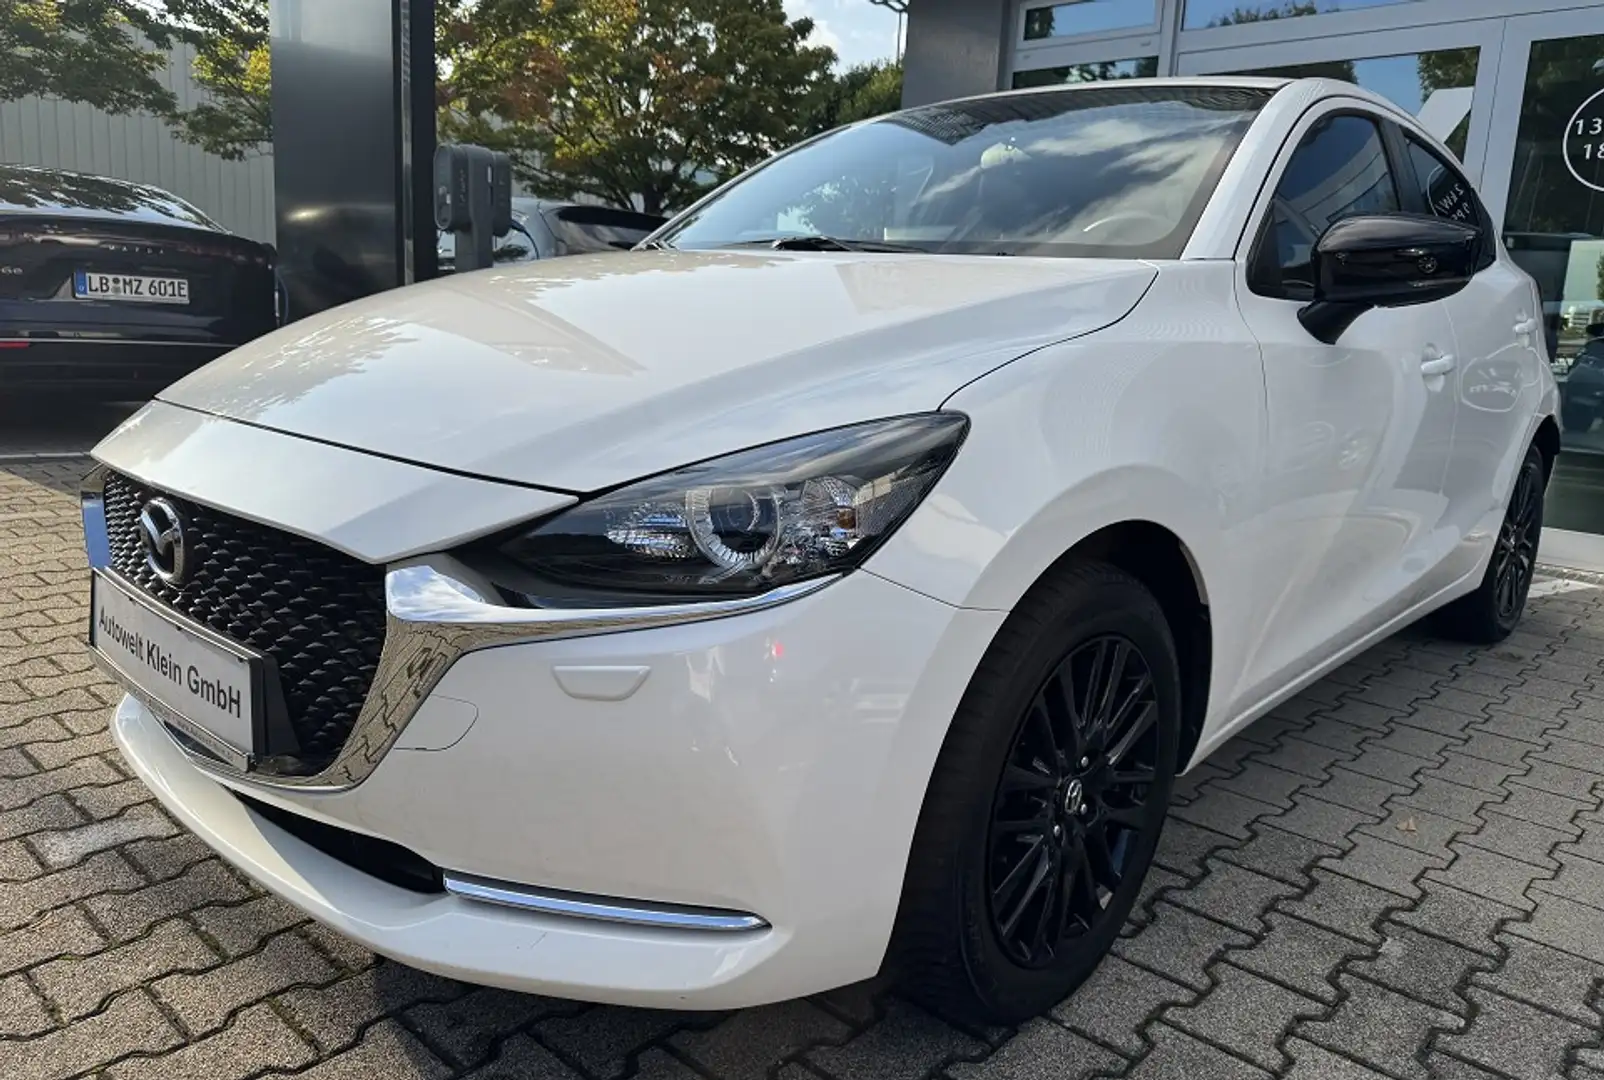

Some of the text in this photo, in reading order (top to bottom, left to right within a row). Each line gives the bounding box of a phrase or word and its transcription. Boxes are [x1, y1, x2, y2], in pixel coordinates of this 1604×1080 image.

[88, 275, 187, 297] LB MZ 601E
[99, 606, 241, 718] Autowelt Klein GmbH
